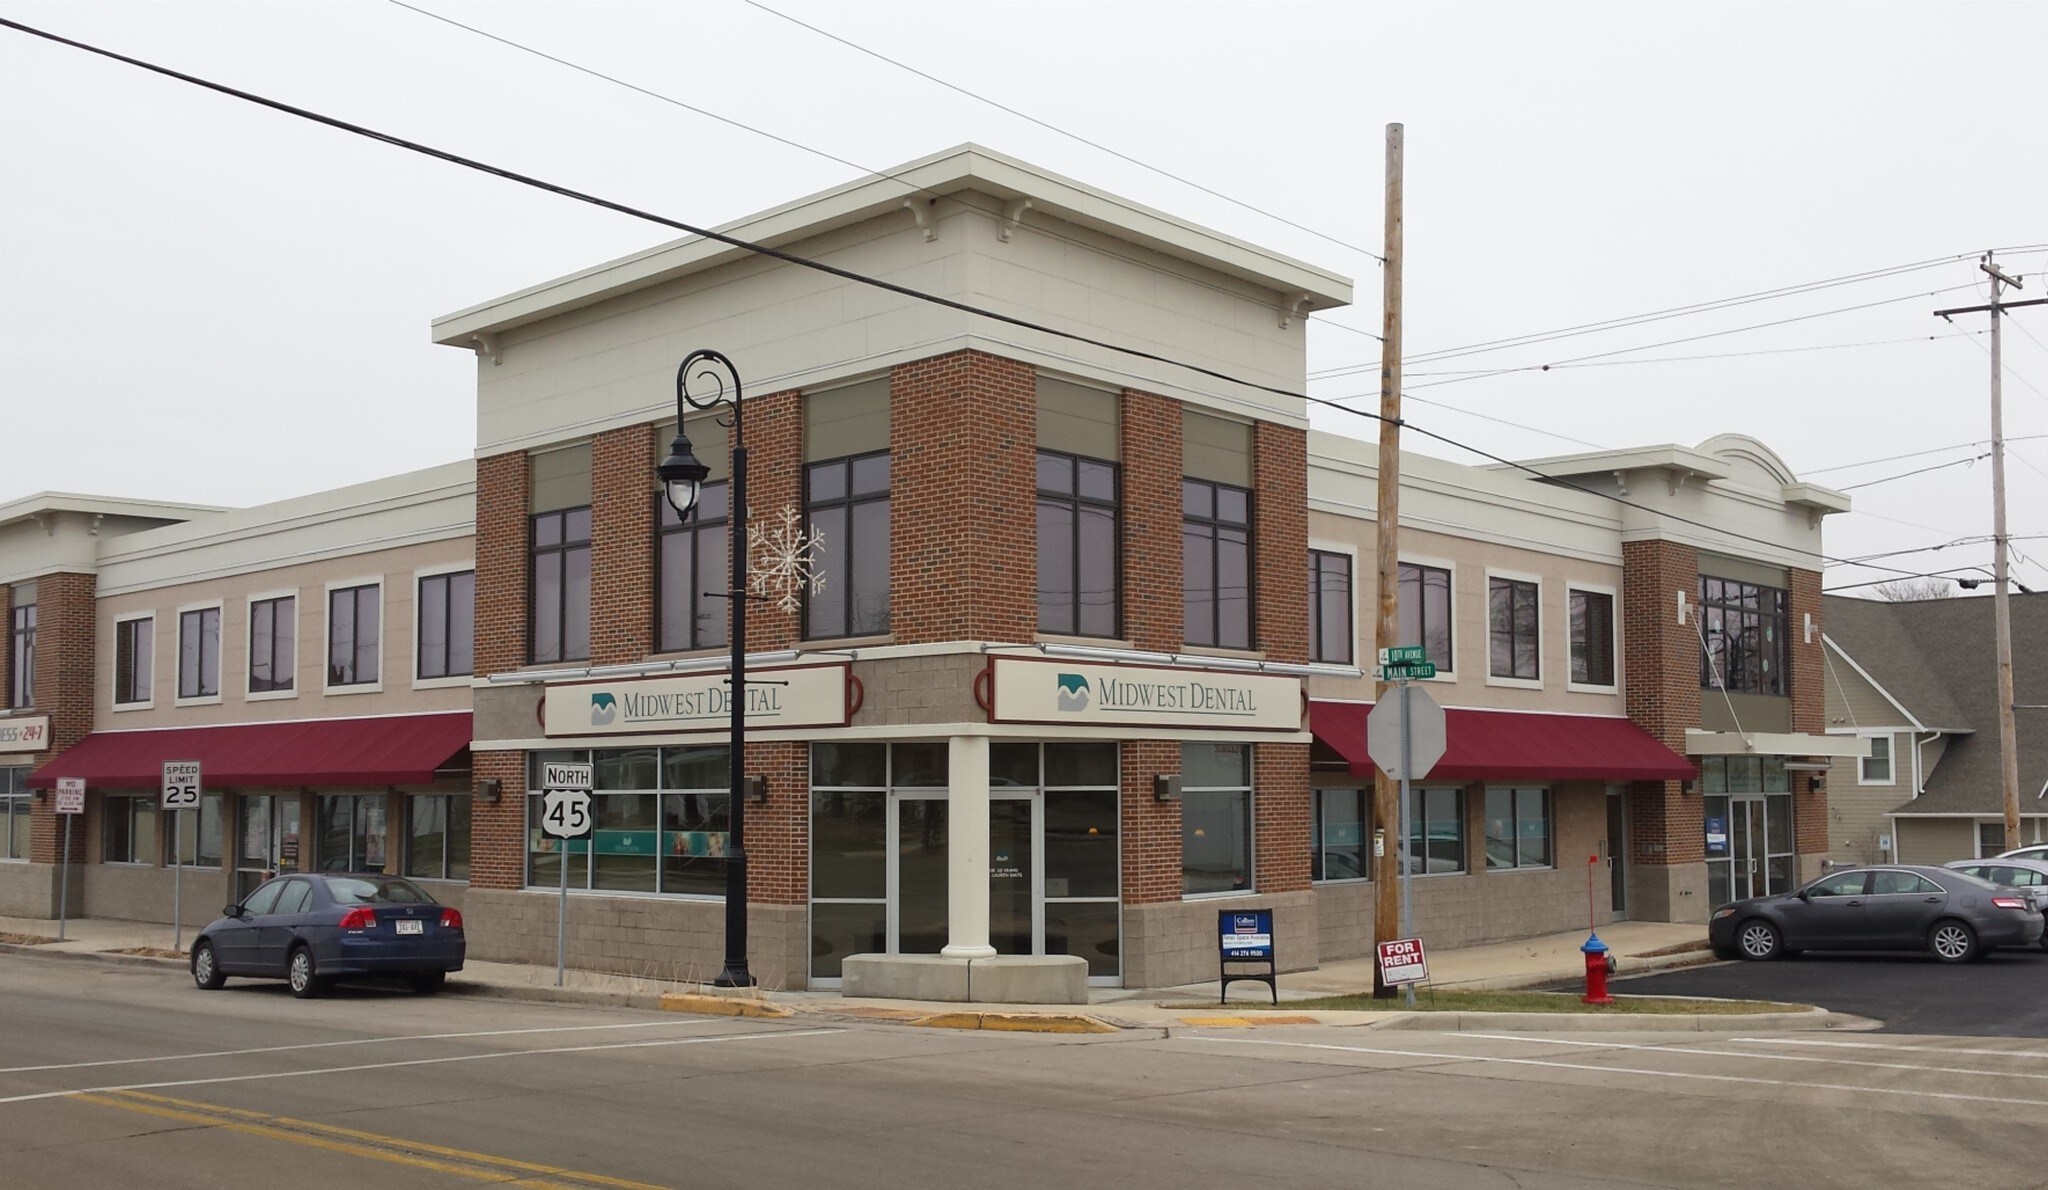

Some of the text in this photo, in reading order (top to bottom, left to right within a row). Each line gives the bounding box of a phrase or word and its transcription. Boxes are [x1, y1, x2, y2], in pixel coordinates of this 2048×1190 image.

[1387, 666, 1432, 679] MAIN STREET
[1098, 677, 1257, 711] MIDWEST DENTAL
[624, 687, 782, 718] MIDWEST DETAL
[0, 726, 18, 742] ESS
[166, 766, 198, 774] SPEED
[548, 768, 589, 784] NORTH
[65, 780, 76, 788] NO
[169, 776, 194, 784] LIMIT
[58, 788, 83, 796] PARKING
[166, 785, 197, 804] 25
[549, 800, 585, 828] 45
[1386, 943, 1414, 955] FOR
[1384, 953, 1420, 967] RENT
